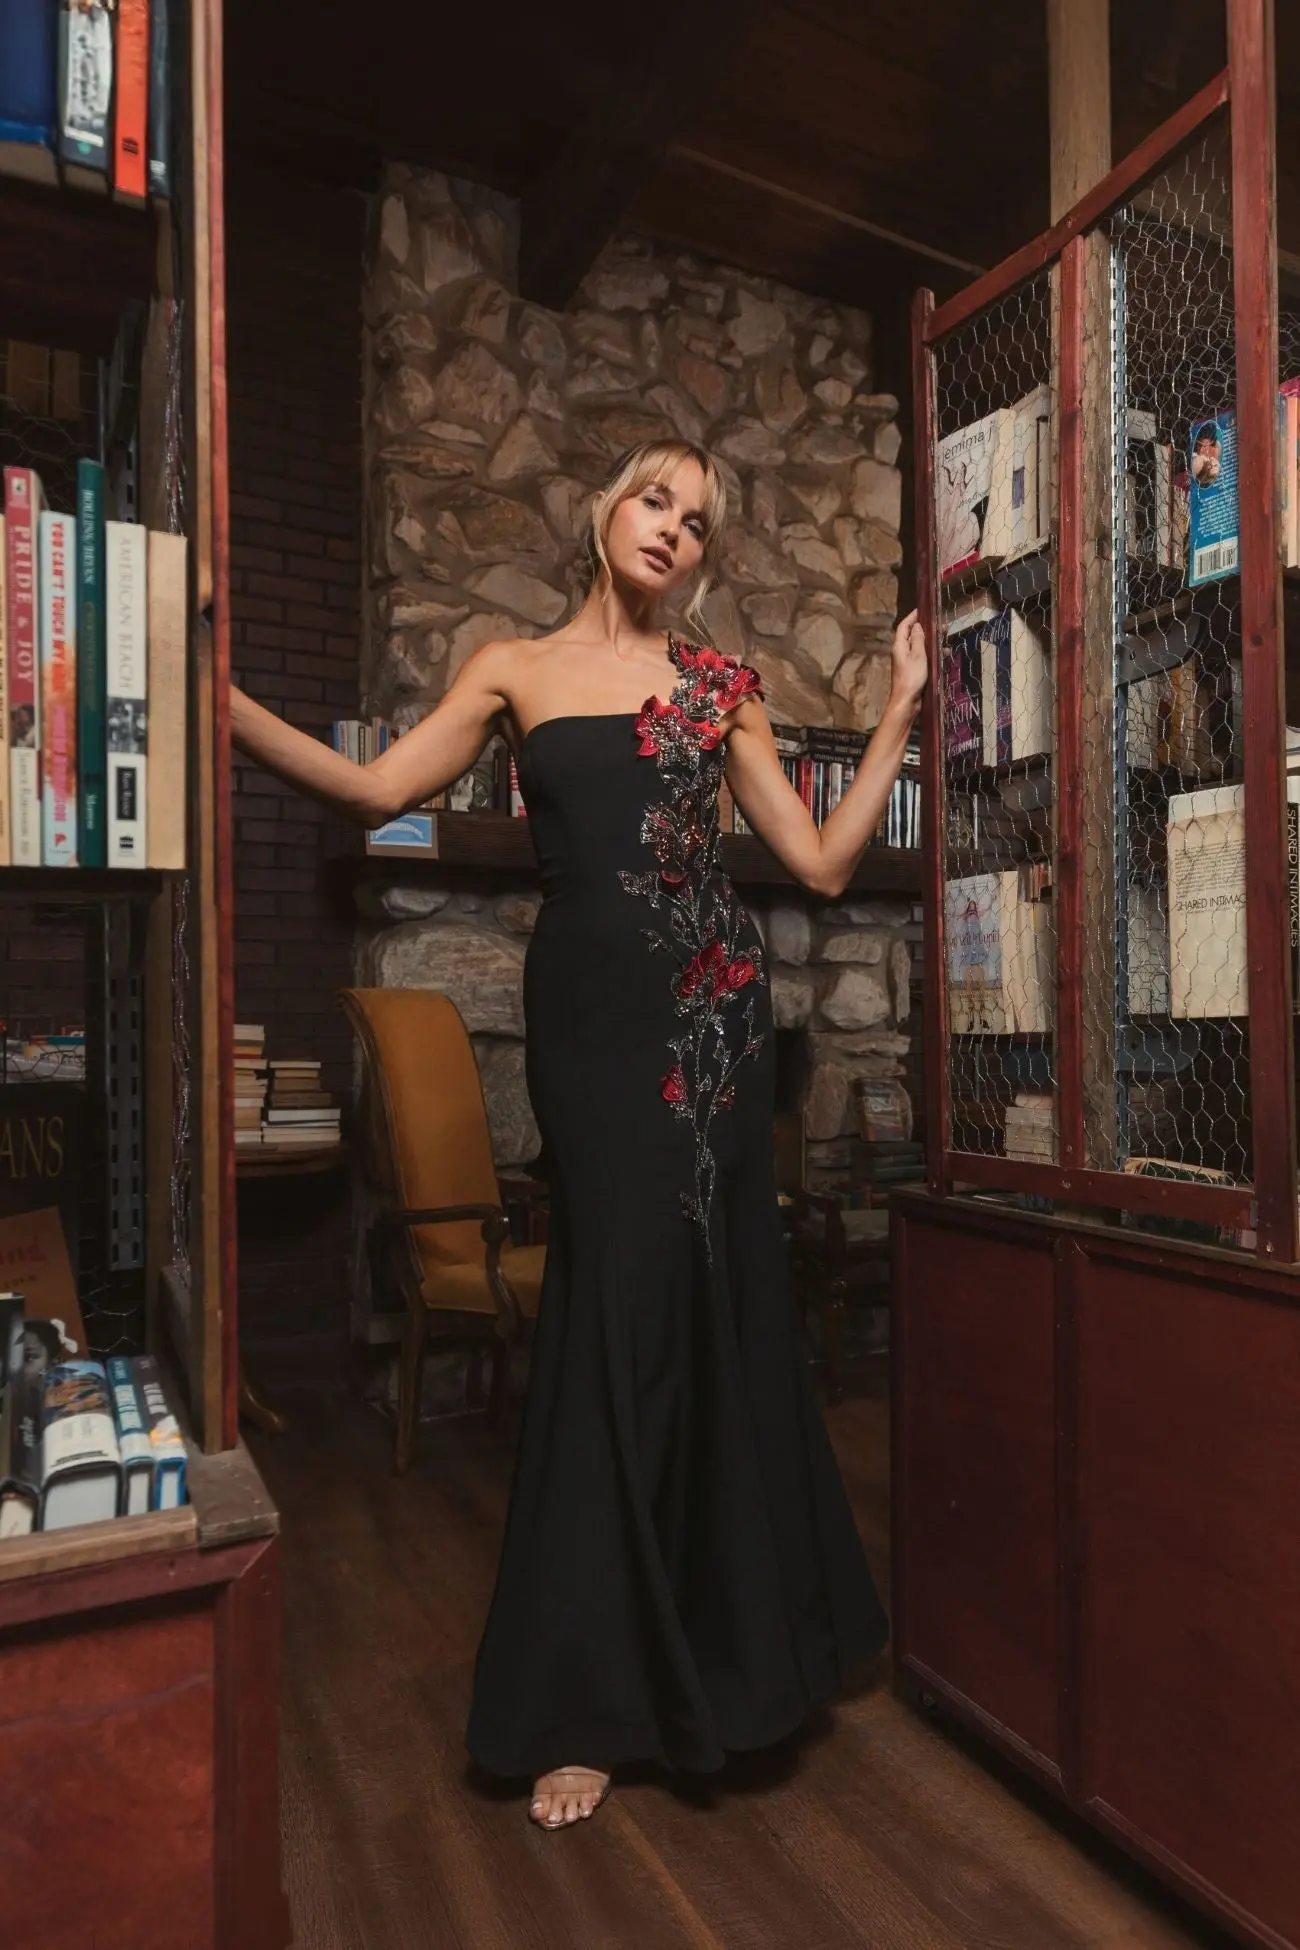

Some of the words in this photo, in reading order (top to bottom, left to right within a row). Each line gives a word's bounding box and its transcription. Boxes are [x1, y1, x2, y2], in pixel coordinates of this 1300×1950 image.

[943, 429, 985, 467] jemima
[52, 521, 64, 547] YOU
[15, 526, 32, 604] PRIDE
[52, 551, 65, 590] CAN'T
[118, 536, 133, 626] AMERICAN
[17, 616, 26, 628] &
[53, 596, 65, 635] TOUCH
[17, 640, 33, 682] JOY
[53, 639, 66, 663] MY
[118, 632, 134, 690] BEACH
[1287, 809, 1298, 865] SHARED
[1176, 898, 1208, 911] SHARED
[1288, 867, 1299, 948] INTIMACIES
